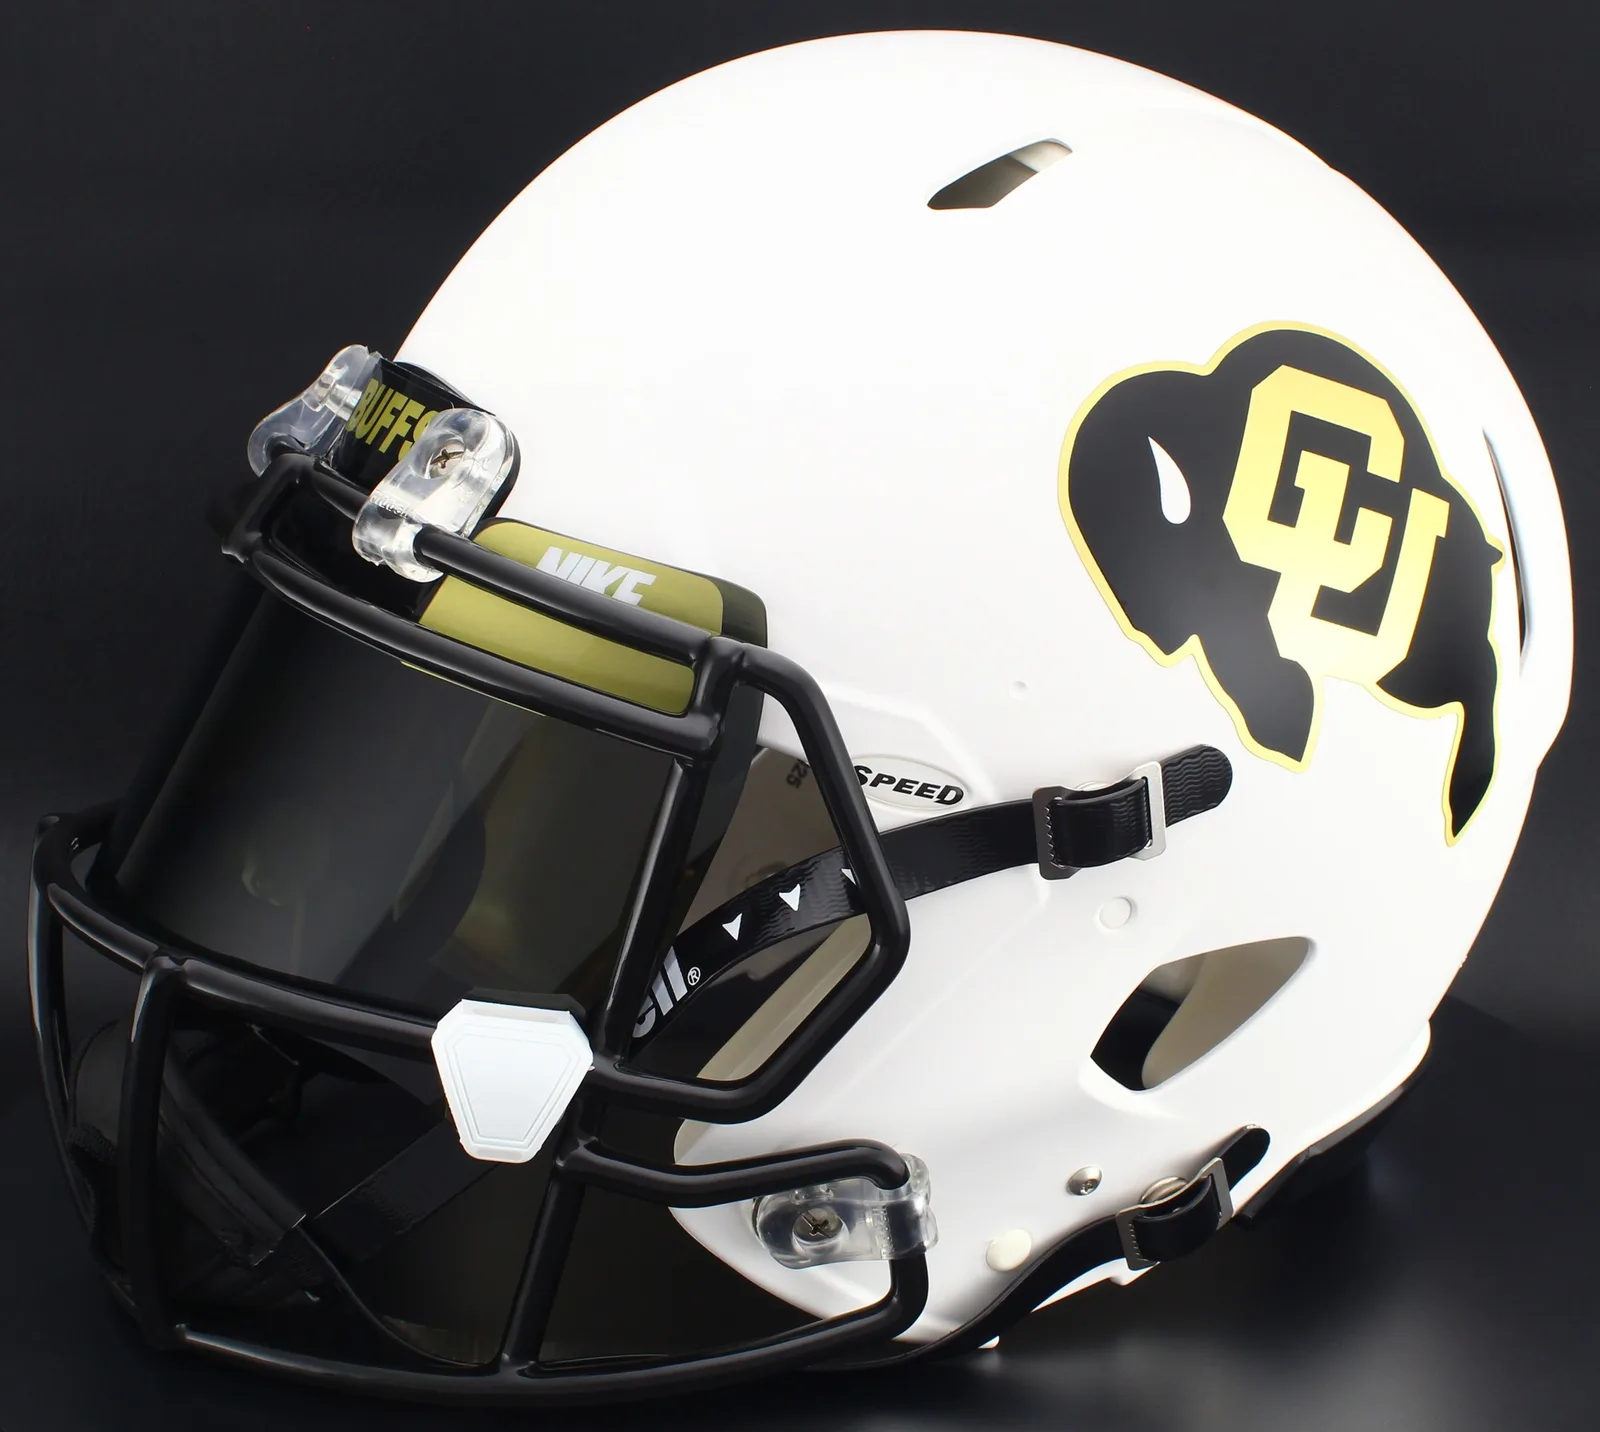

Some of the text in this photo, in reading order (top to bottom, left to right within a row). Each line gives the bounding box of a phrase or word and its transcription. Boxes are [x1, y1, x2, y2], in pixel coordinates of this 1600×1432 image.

[1222, 364, 1451, 685] CU
[535, 545, 657, 606] NIKE
[853, 765, 964, 806] SPEED
